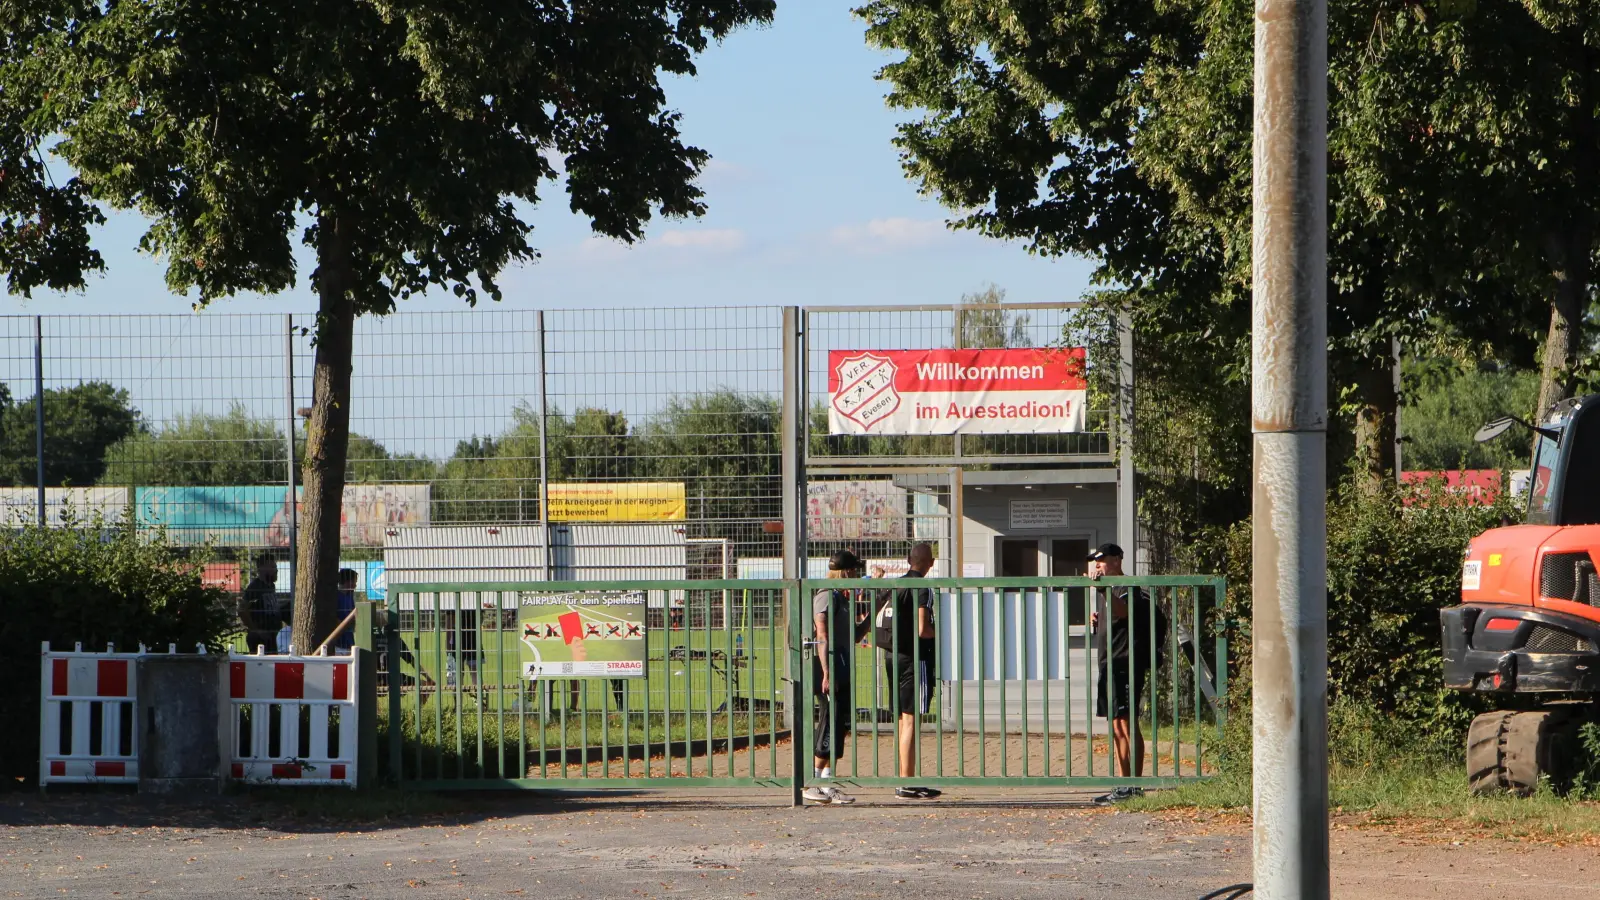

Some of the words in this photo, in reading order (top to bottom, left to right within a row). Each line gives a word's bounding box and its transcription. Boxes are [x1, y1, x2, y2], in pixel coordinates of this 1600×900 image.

[915, 363, 1044, 381] Willkommen
[862, 395, 892, 420] Evesen
[916, 402, 940, 419] im
[946, 401, 1071, 419] Auestadion!
[565, 498, 612, 507] Arbeitgeber
[639, 498, 667, 507] Region
[565, 508, 608, 516] bewerben!
[522, 595, 563, 605] FAIRPLAY
[565, 594, 577, 605] für
[580, 595, 599, 605] dein
[602, 595, 642, 607] Spielfeld!
